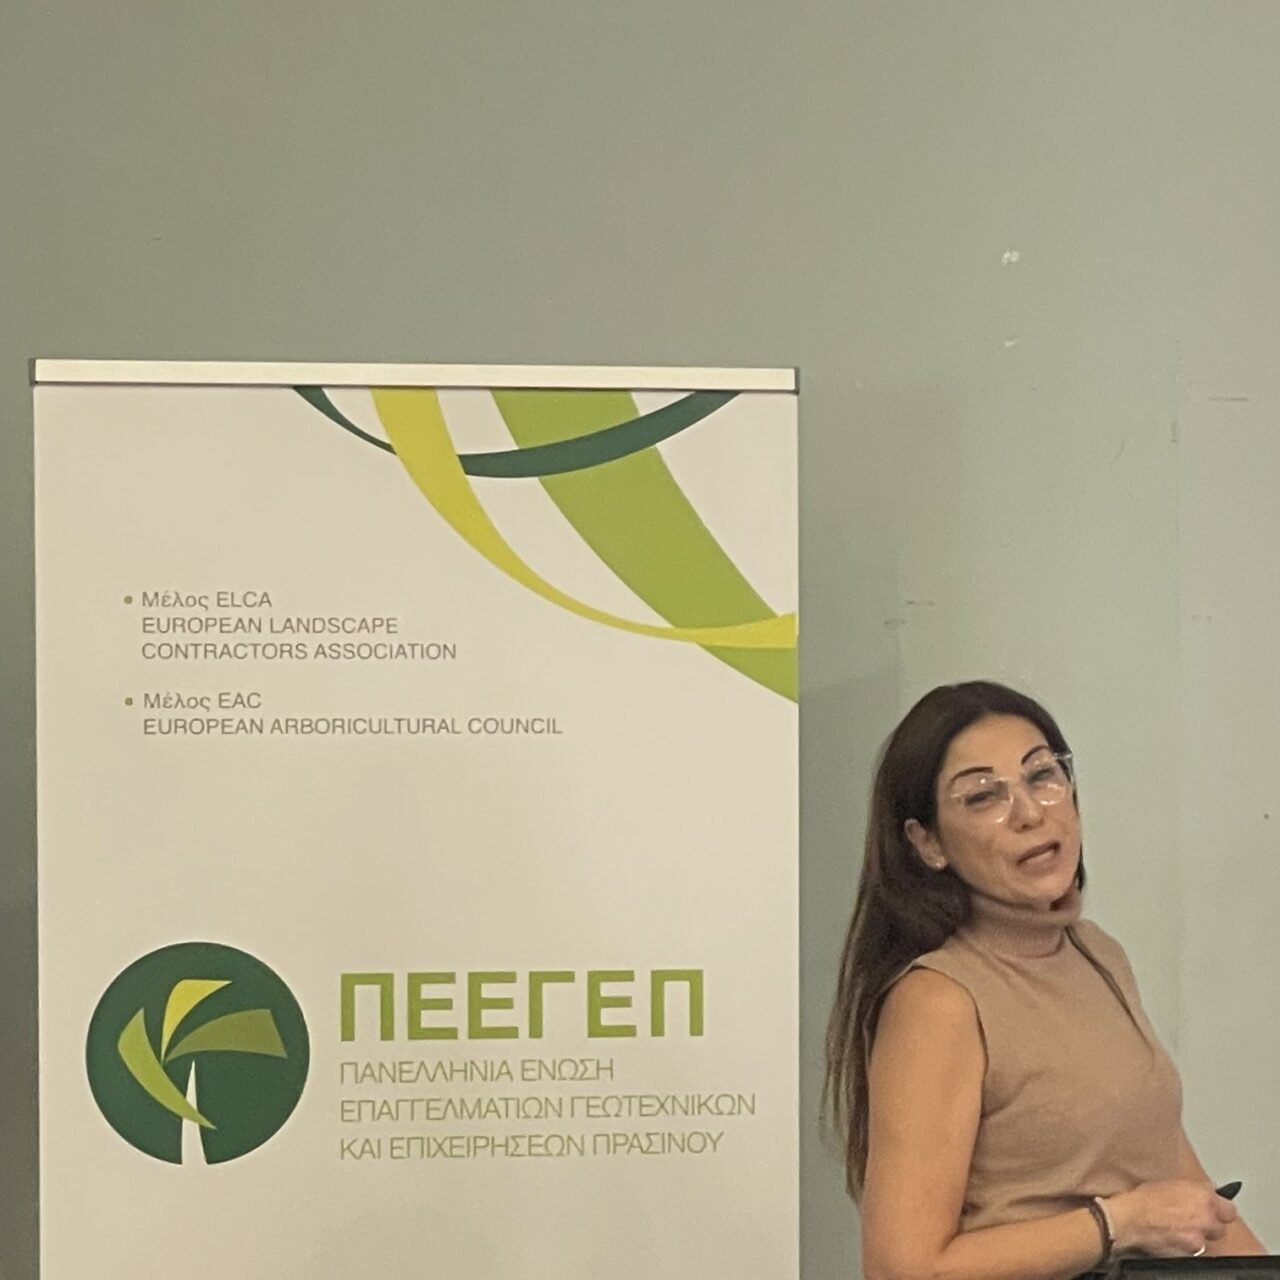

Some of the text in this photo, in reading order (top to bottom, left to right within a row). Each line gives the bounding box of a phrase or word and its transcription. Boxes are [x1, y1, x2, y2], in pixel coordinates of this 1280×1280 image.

[143, 591, 272, 611] Μέλος ELCA
[143, 617, 398, 634] EUROPEAN LANDSCAPE
[142, 643, 456, 660] CONTRACTORS ASSOCIATION
[144, 692, 261, 712] Μέλος EAC
[144, 718, 563, 735] EUROPEAN ARBORICULTURAL COUNCIL
[340, 969, 703, 1042] ΠΕΕΓΕΠ
[341, 1058, 613, 1084] ΠΑΝΕΛΛΗΝΙΑ ΕΝΩΣΗ
[341, 1094, 755, 1122] ΕΠΑΓΓΕΛΜΑΤΙΩΝ ΓΕΩΤΕΧΝΙΚΩΝ
[341, 1132, 724, 1160] ΚΑΙ ΕΠΙΧΕΙΡΗΣΕΩΝ ΠΡΑΣΙΝΟΥ
